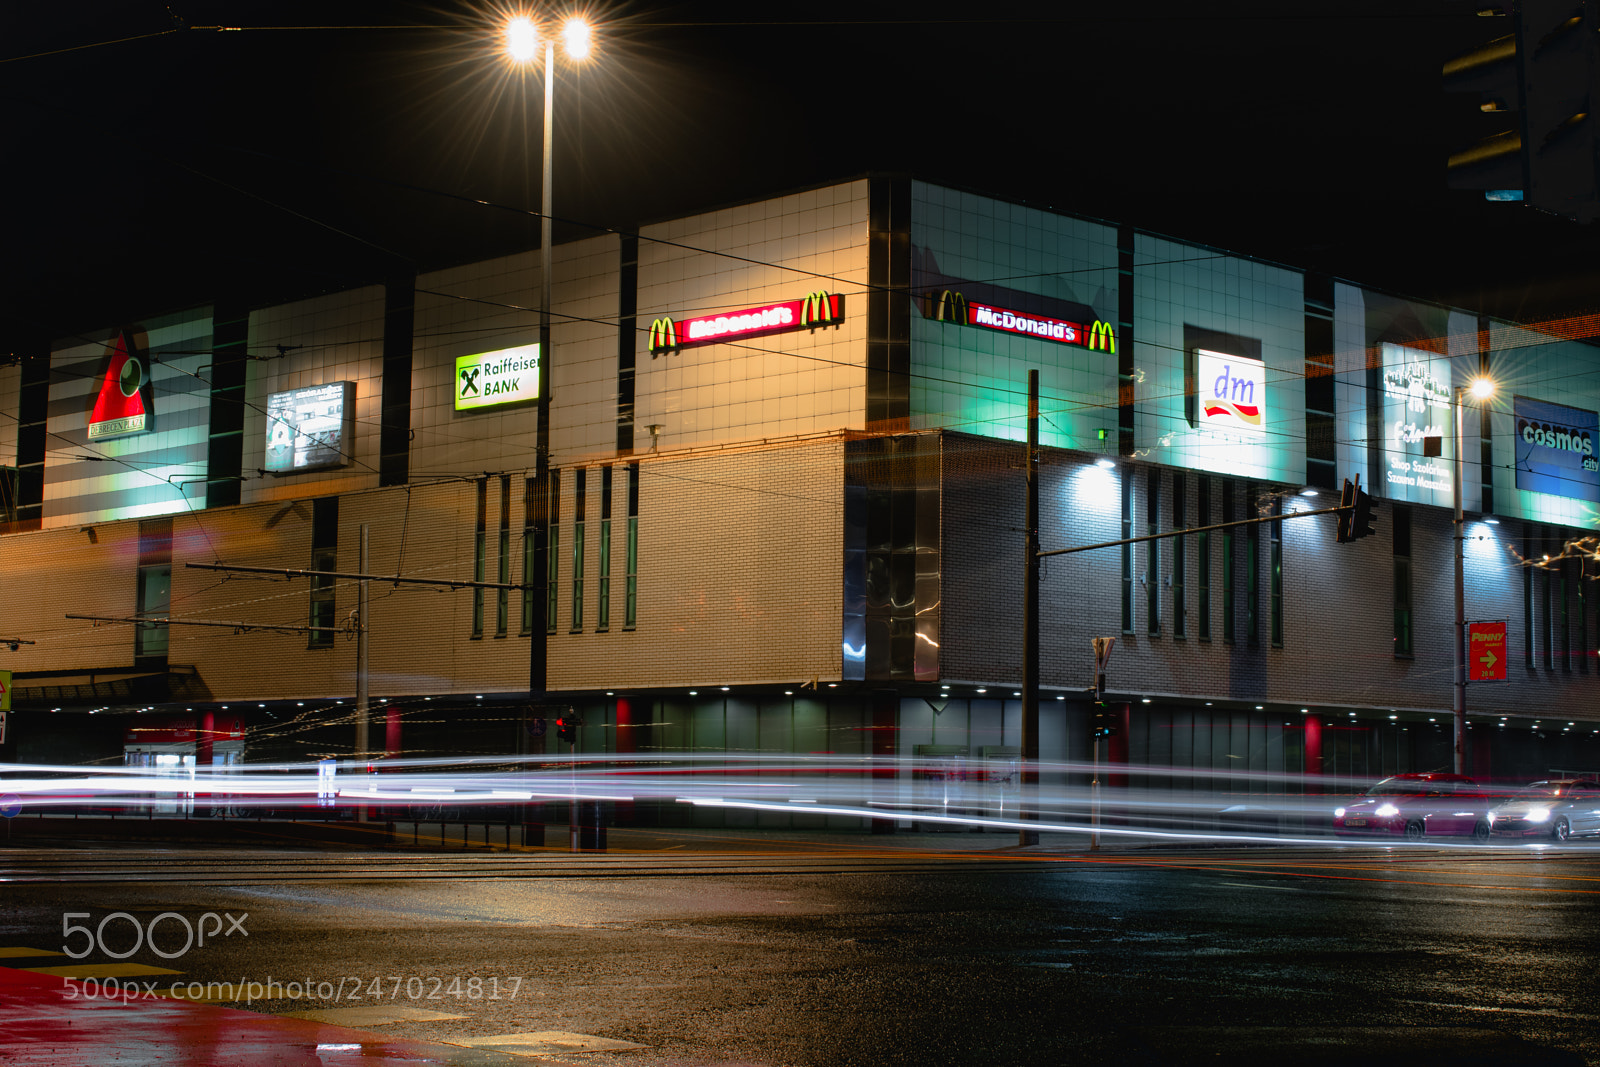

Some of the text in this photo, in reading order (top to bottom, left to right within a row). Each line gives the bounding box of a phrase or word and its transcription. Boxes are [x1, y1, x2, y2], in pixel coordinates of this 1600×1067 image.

[689, 306, 794, 339] McDonald's
[976, 306, 1076, 342] McDonald's
[484, 377, 520, 397] BANK
[1214, 365, 1254, 404] dm
[90, 417, 143, 435] DEBRECEN PLAZA
[1523, 426, 1593, 455] cosmos
[1391, 457, 1411, 473] Shop
[1583, 458, 1600, 472] city
[1471, 632, 1505, 642] PENNY
